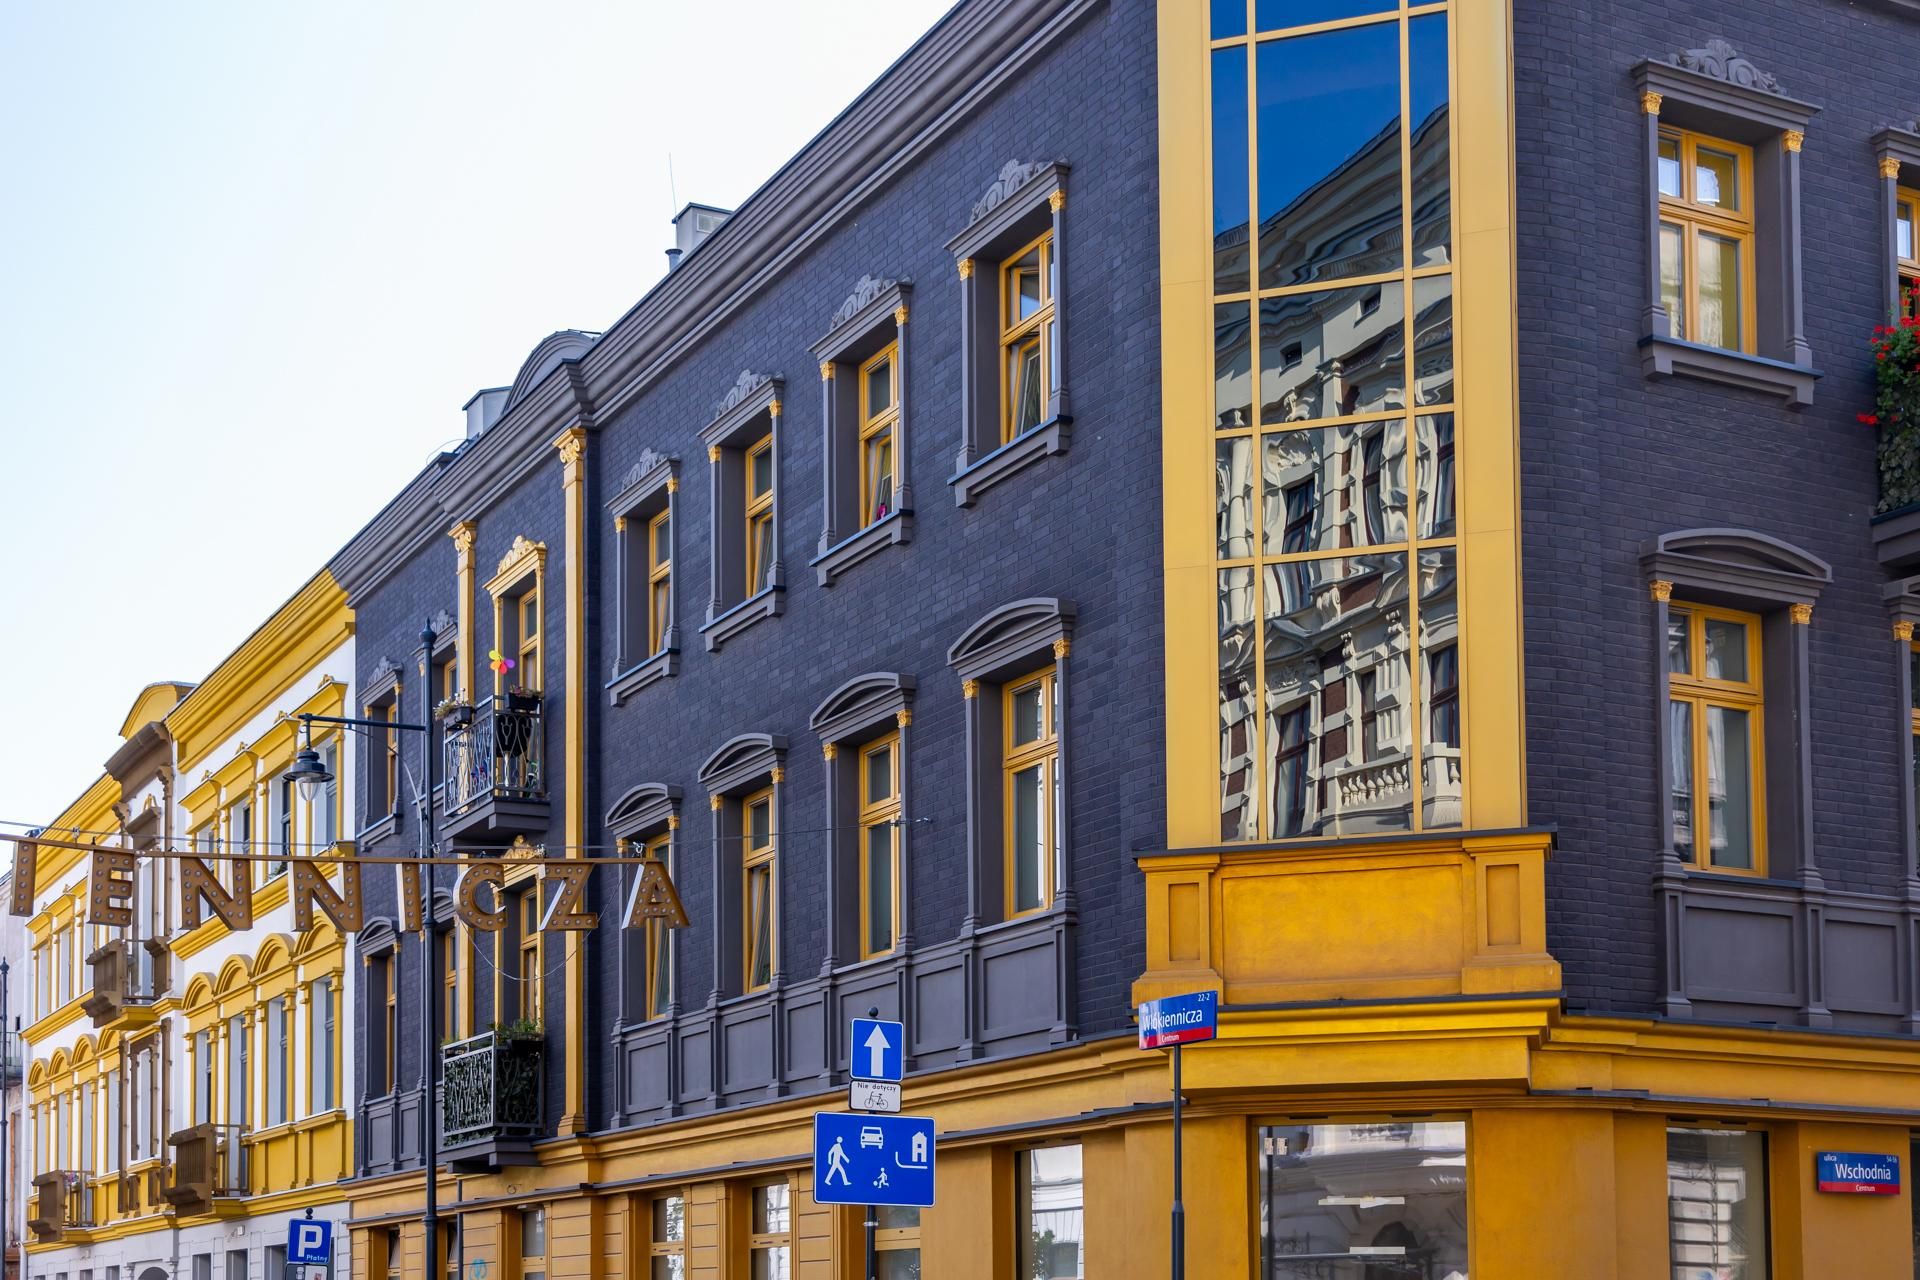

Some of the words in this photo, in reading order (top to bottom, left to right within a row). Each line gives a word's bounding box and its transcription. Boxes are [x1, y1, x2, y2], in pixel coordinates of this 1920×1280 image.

[1198, 993, 1210, 1001] 22-2
[1143, 1008, 1203, 1031] Włókiennicza
[1161, 1035, 1179, 1043] Centrum
[872, 1084, 896, 1092] dotyczy
[1823, 1154, 1837, 1162] ulica
[1835, 1163, 1891, 1180] Wschodnia
[1856, 1184, 1875, 1192] Centrum
[298, 1224, 323, 1257] P
